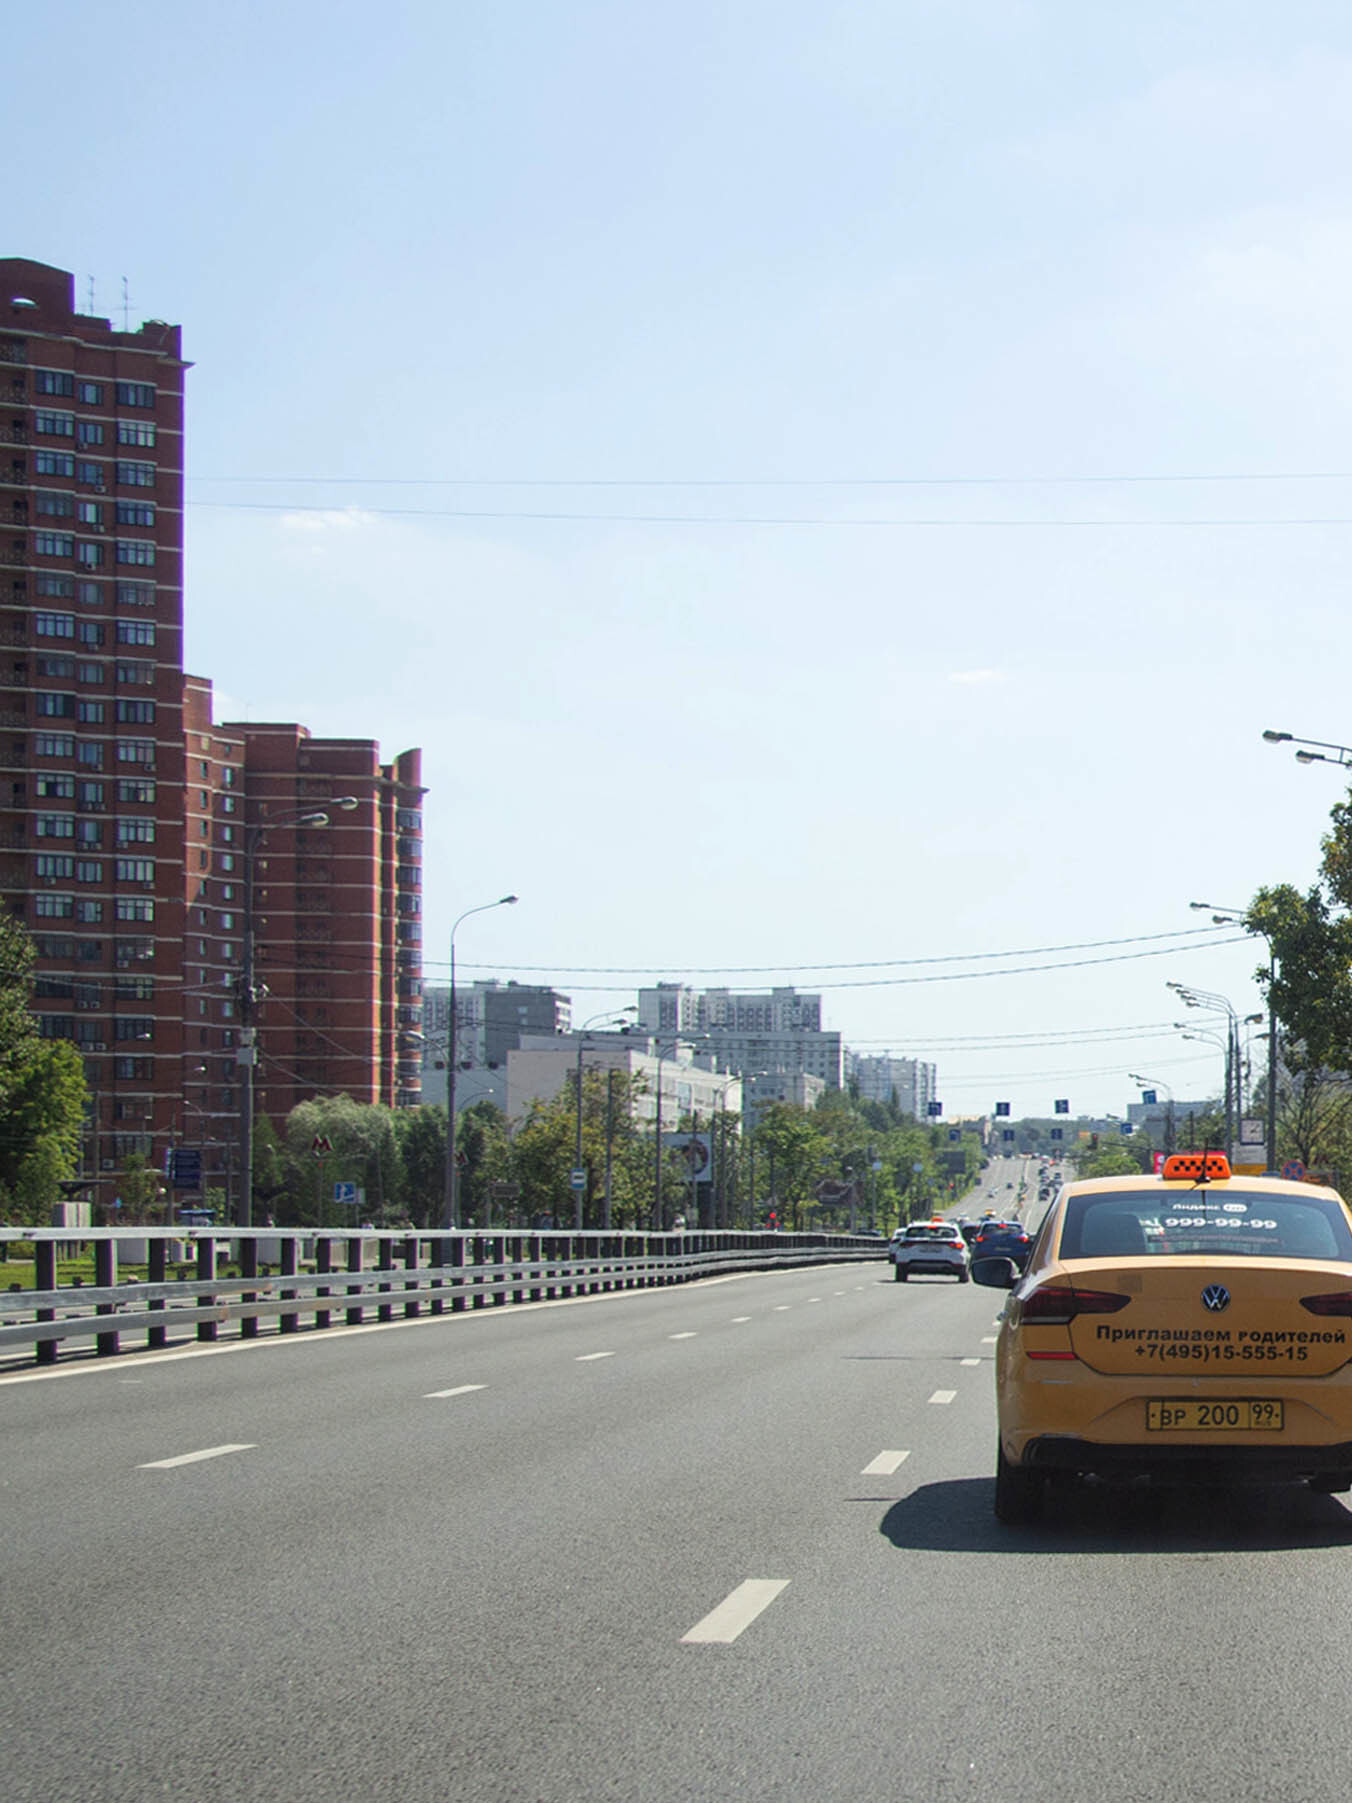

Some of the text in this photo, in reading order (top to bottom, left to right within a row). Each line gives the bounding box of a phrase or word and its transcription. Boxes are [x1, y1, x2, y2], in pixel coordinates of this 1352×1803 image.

[1096, 1325, 1231, 1343] Приглашаем
[1135, 1343, 1309, 1362] +7(495)15-555-15
[1197, 1404, 1240, 1425] 200
[1252, 1403, 1275, 1420] 99
